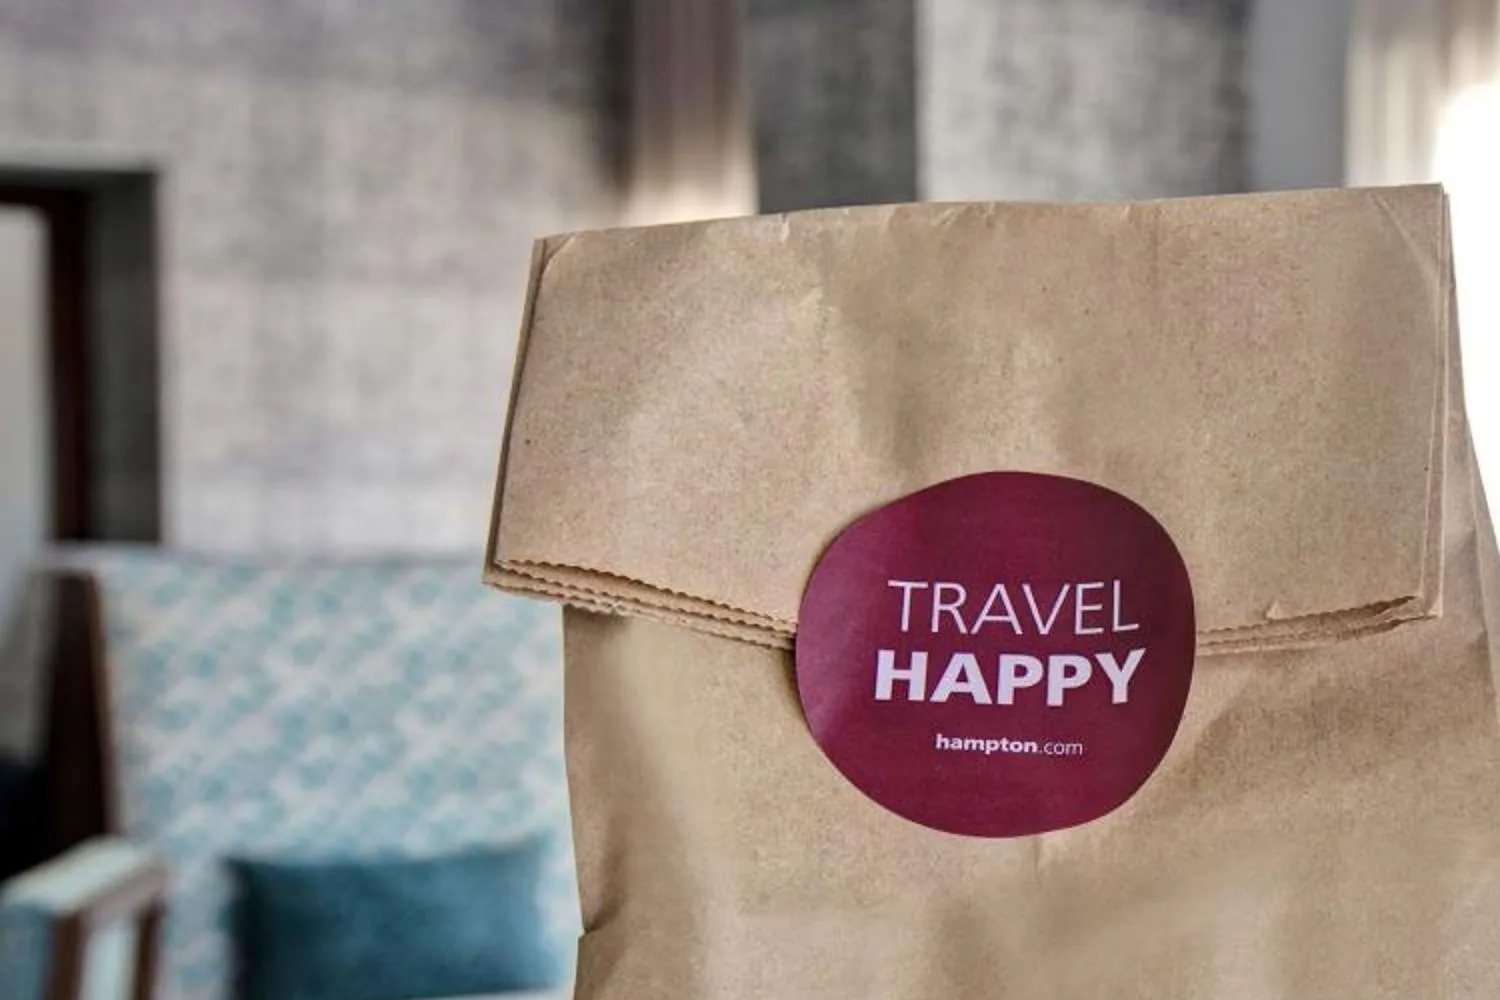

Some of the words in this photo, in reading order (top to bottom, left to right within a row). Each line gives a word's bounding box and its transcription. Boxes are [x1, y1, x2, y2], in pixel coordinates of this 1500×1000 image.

[886, 579, 1141, 636] TRAVEL
[873, 647, 1147, 708] HAPPY
[935, 732, 1084, 757] hampton.com
